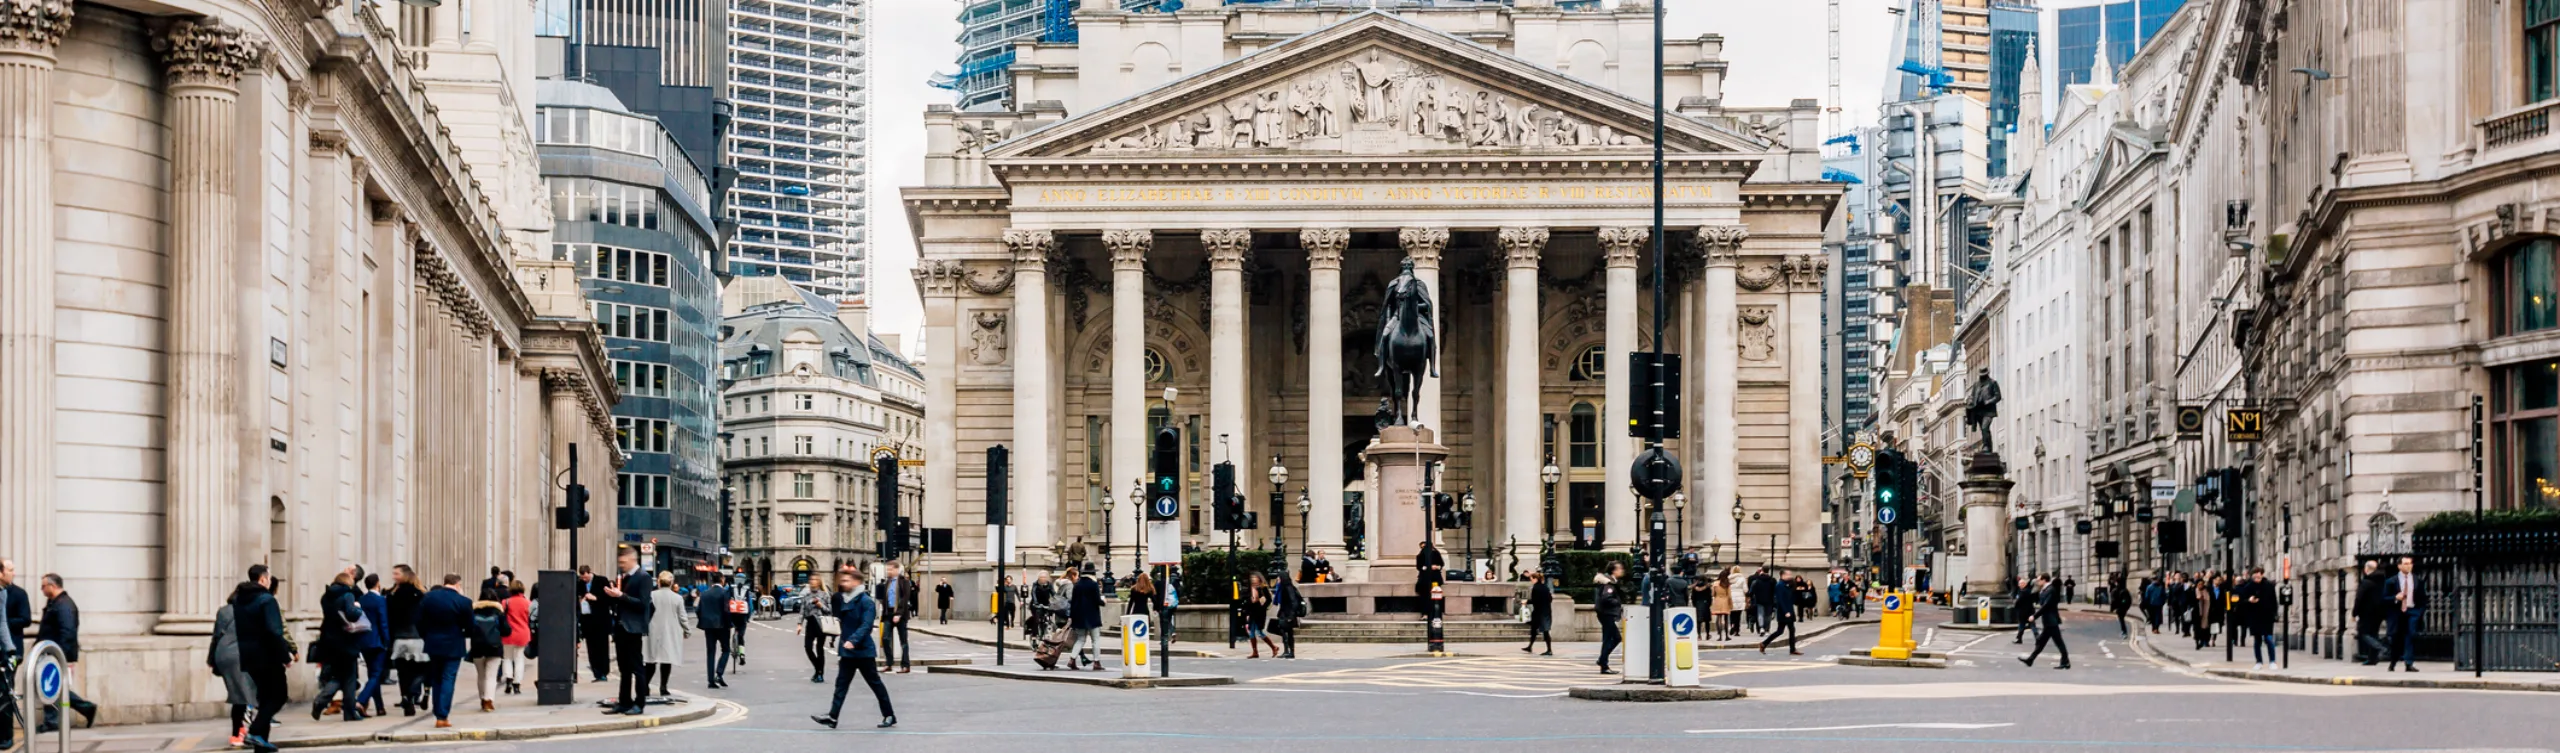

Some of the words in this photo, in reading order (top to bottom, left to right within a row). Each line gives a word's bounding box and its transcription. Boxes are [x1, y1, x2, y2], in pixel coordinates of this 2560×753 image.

[1039, 188, 1087, 202] ANNO
[1097, 188, 1214, 201] ELIZABETHAE
[1224, 188, 1235, 201] R
[1244, 188, 1270, 201] XIII
[1279, 187, 1364, 201] CONDITVM
[1384, 187, 1432, 200] ANNO
[1442, 186, 1529, 200] VICTORIAE
[1539, 186, 1550, 199] R
[1559, 186, 1585, 199] VIII
